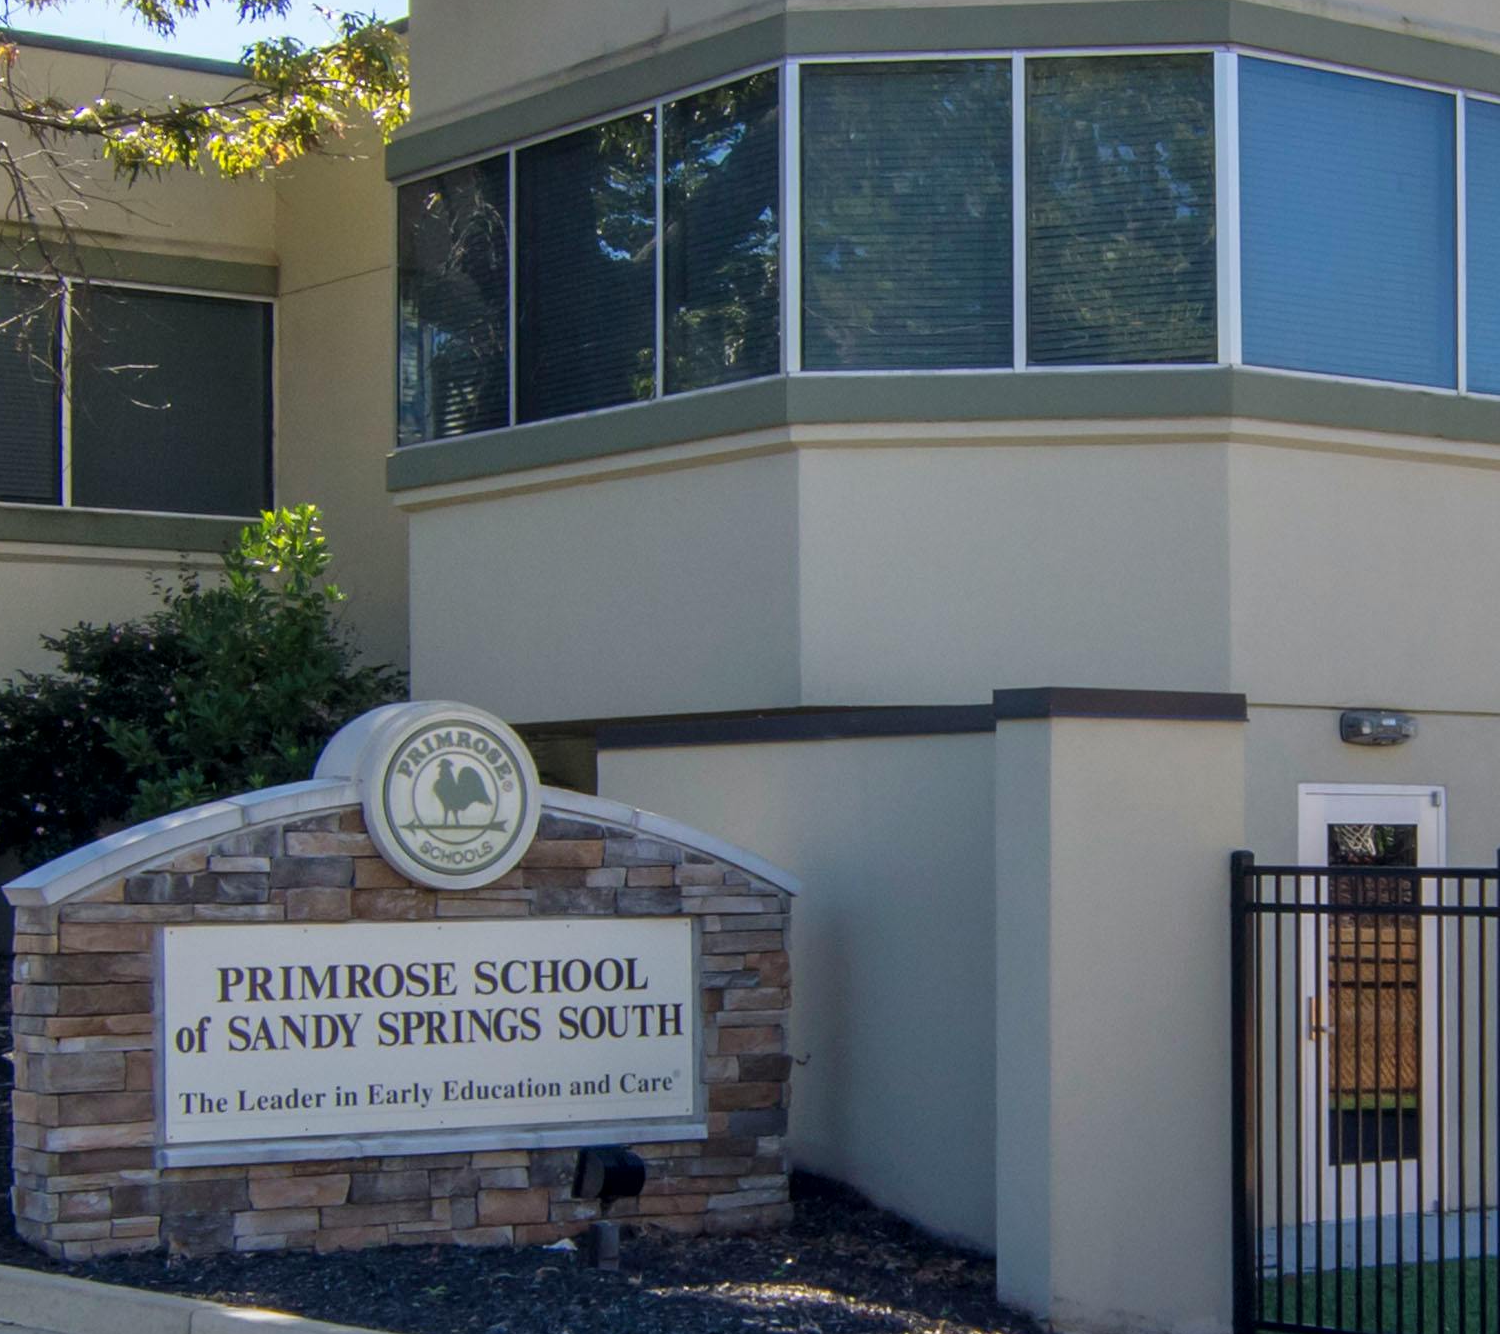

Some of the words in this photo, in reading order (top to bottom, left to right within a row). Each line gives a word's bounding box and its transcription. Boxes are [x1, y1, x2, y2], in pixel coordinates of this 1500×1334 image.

[419, 840, 494, 865] SCHOOLS
[216, 961, 458, 1003] PRIMROSE
[474, 957, 649, 996] SCHOOL
[175, 1016, 212, 1054] of
[228, 1012, 363, 1052] SANDY
[378, 1006, 542, 1047] SPRINGS
[558, 1003, 684, 1041] SOUTH
[179, 1091, 228, 1115] The
[237, 1087, 327, 1112] Leader
[335, 1085, 358, 1107] in
[367, 1082, 433, 1109] Early
[442, 1077, 561, 1102] Education
[569, 1073, 611, 1097] and
